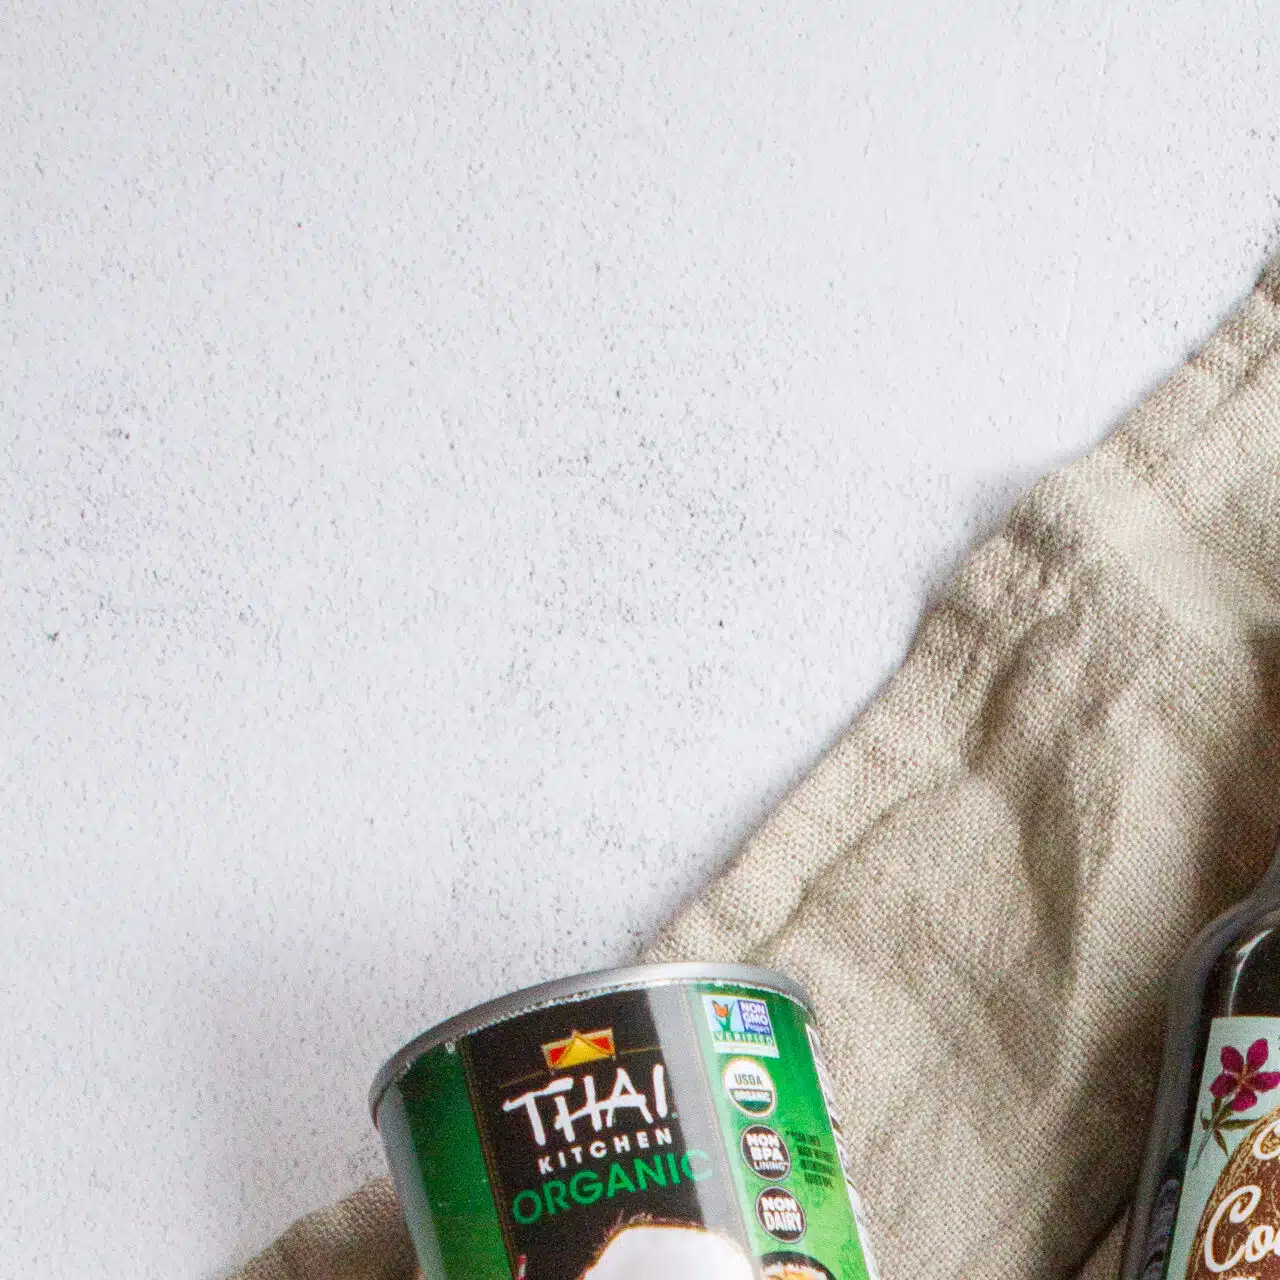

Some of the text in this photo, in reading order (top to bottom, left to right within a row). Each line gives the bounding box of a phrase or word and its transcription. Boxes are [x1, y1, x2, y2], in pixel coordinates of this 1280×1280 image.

[734, 1073, 763, 1086] USDA
[502, 1064, 668, 1146] THAI
[745, 1133, 780, 1147] NON
[538, 1128, 672, 1175] KITCHEN
[750, 1146, 785, 1161] BPA
[512, 1149, 714, 1225] ORGANIC
[761, 1197, 797, 1212] NON
[764, 1211, 803, 1231] DAIRY
